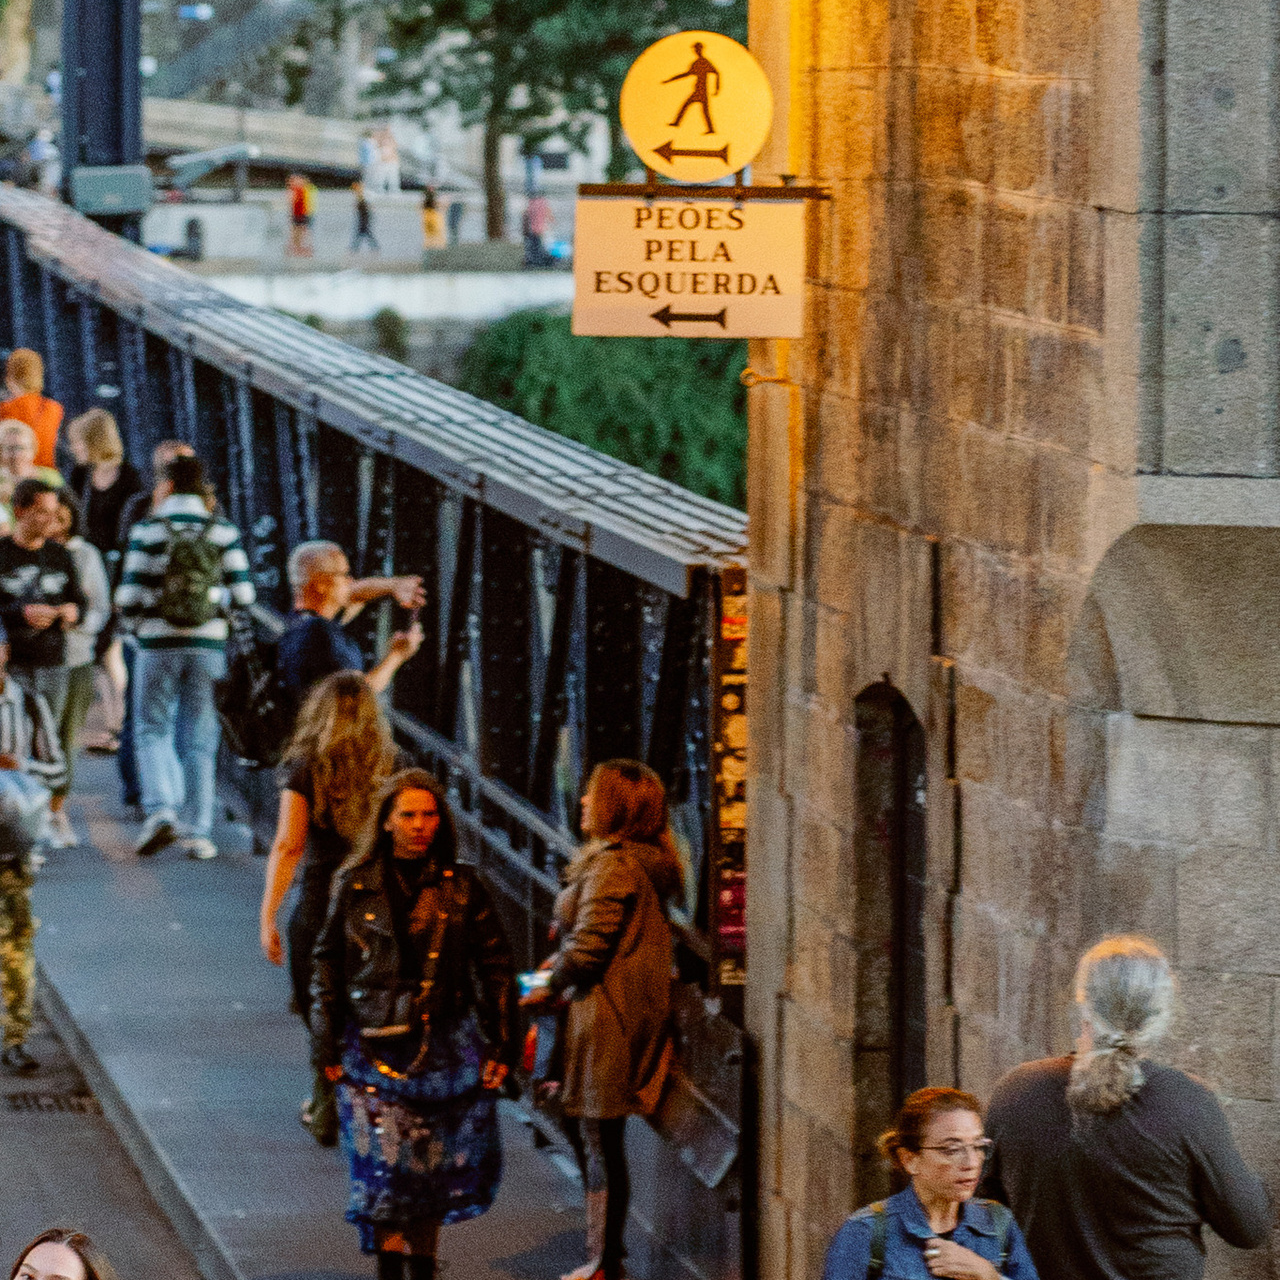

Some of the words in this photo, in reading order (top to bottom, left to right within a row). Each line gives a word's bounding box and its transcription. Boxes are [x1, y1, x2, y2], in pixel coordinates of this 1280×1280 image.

[633, 201, 745, 230] PEÕES
[644, 238, 733, 262] PELA
[593, 270, 782, 299] ESQUERDA
